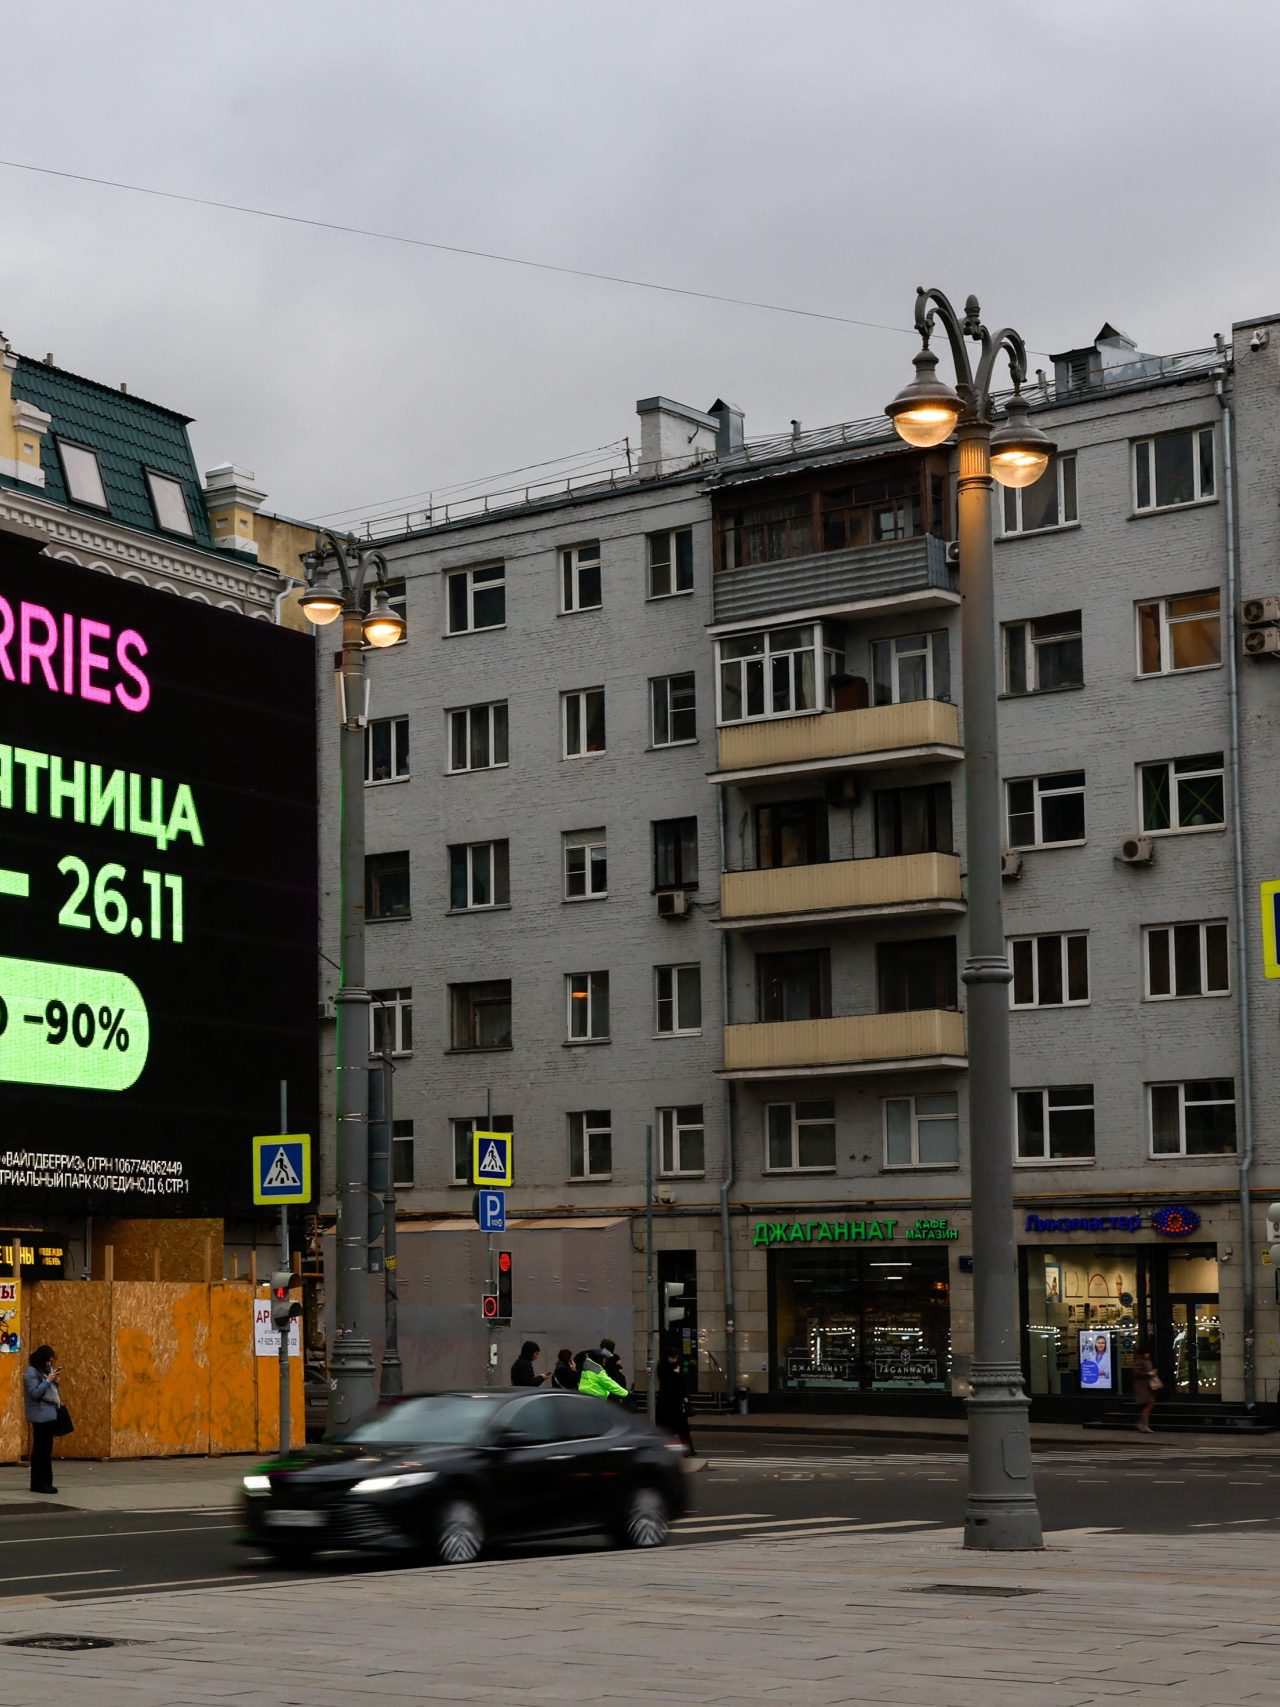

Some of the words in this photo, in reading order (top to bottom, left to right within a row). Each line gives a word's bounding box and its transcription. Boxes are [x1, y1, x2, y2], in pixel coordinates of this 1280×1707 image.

[56, 856, 186, 944] 26.11
[64, 1173, 91, 1189] ПАРК
[752, 1219, 898, 1247] ДЖАГАННАТ
[915, 1219, 947, 1230] КАФЕ
[904, 1229, 959, 1241] МАГАЗИН
[3, 1246, 35, 1267] ЦНЫ
